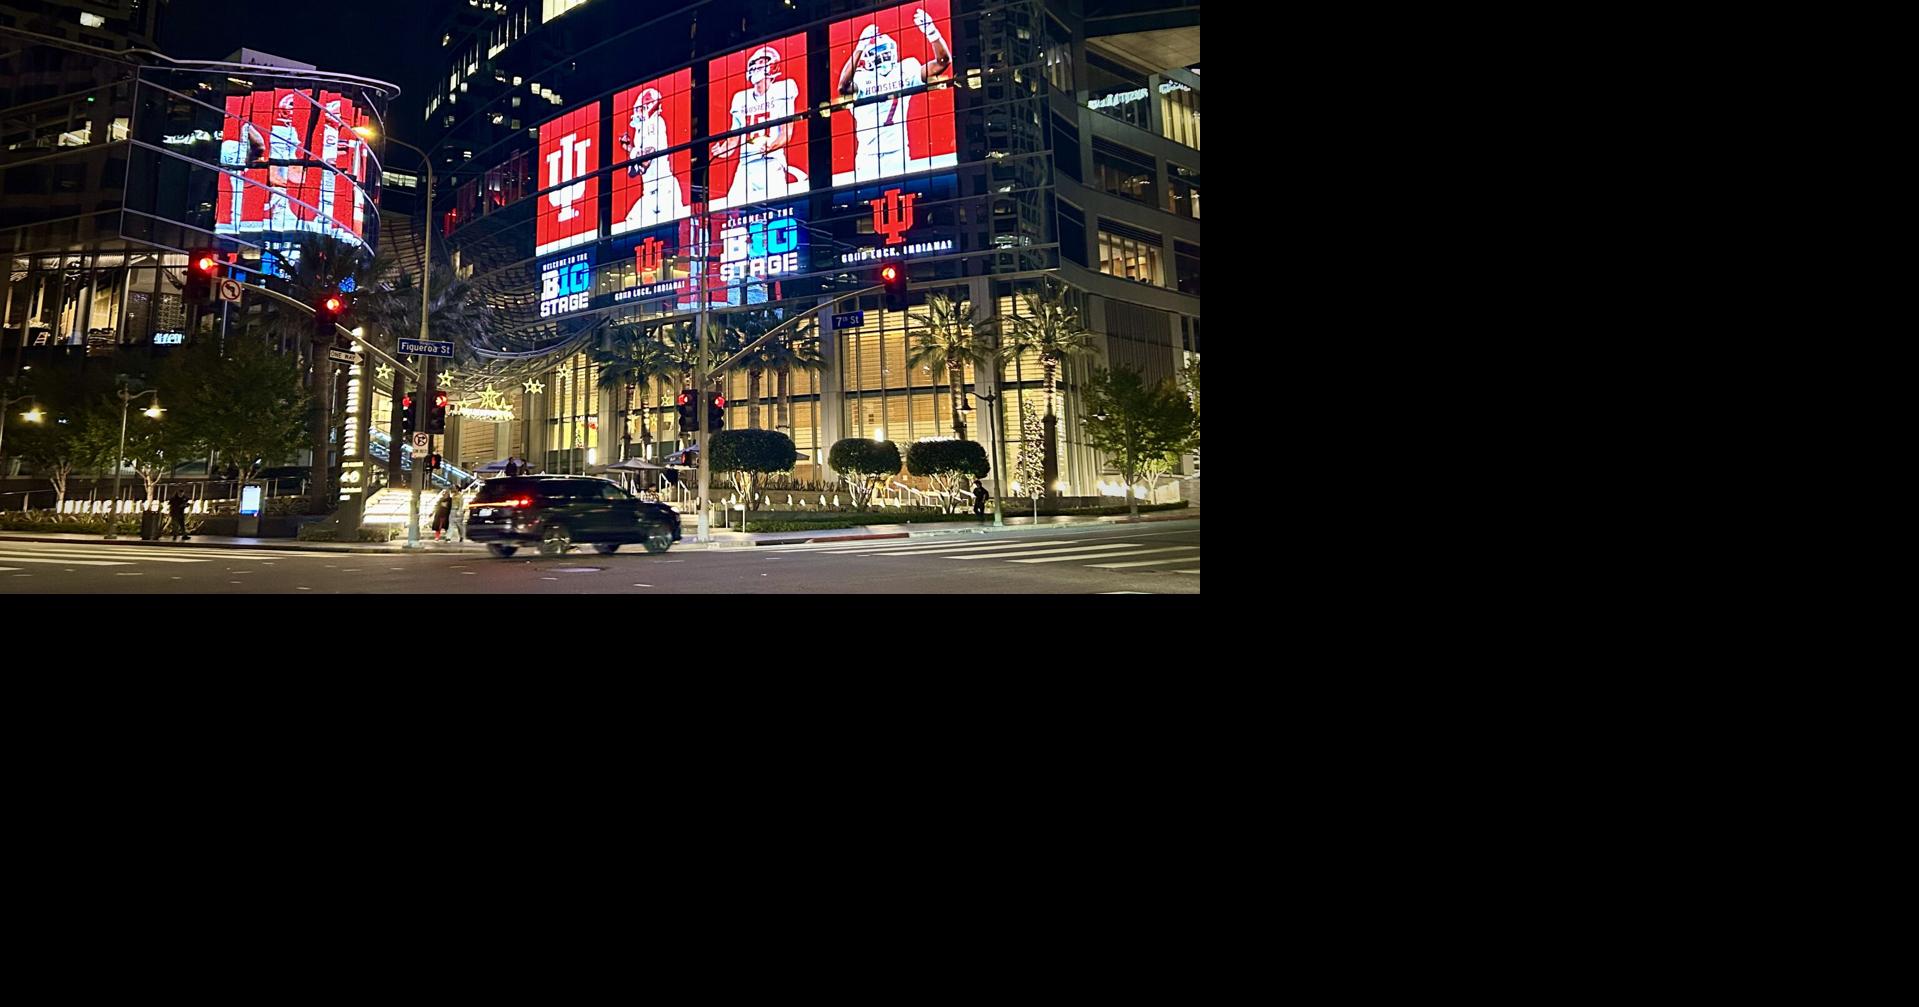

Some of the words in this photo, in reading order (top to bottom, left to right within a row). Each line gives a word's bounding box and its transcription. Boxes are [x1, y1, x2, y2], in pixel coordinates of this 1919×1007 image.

[763, 211, 774, 220] TO
[778, 207, 793, 218] THE
[720, 252, 798, 282] STAGE
[540, 292, 589, 318] STAGE
[850, 315, 859, 325] St
[330, 350, 342, 358] ONE
[401, 342, 438, 353] Figueroa
[440, 345, 450, 354] St
